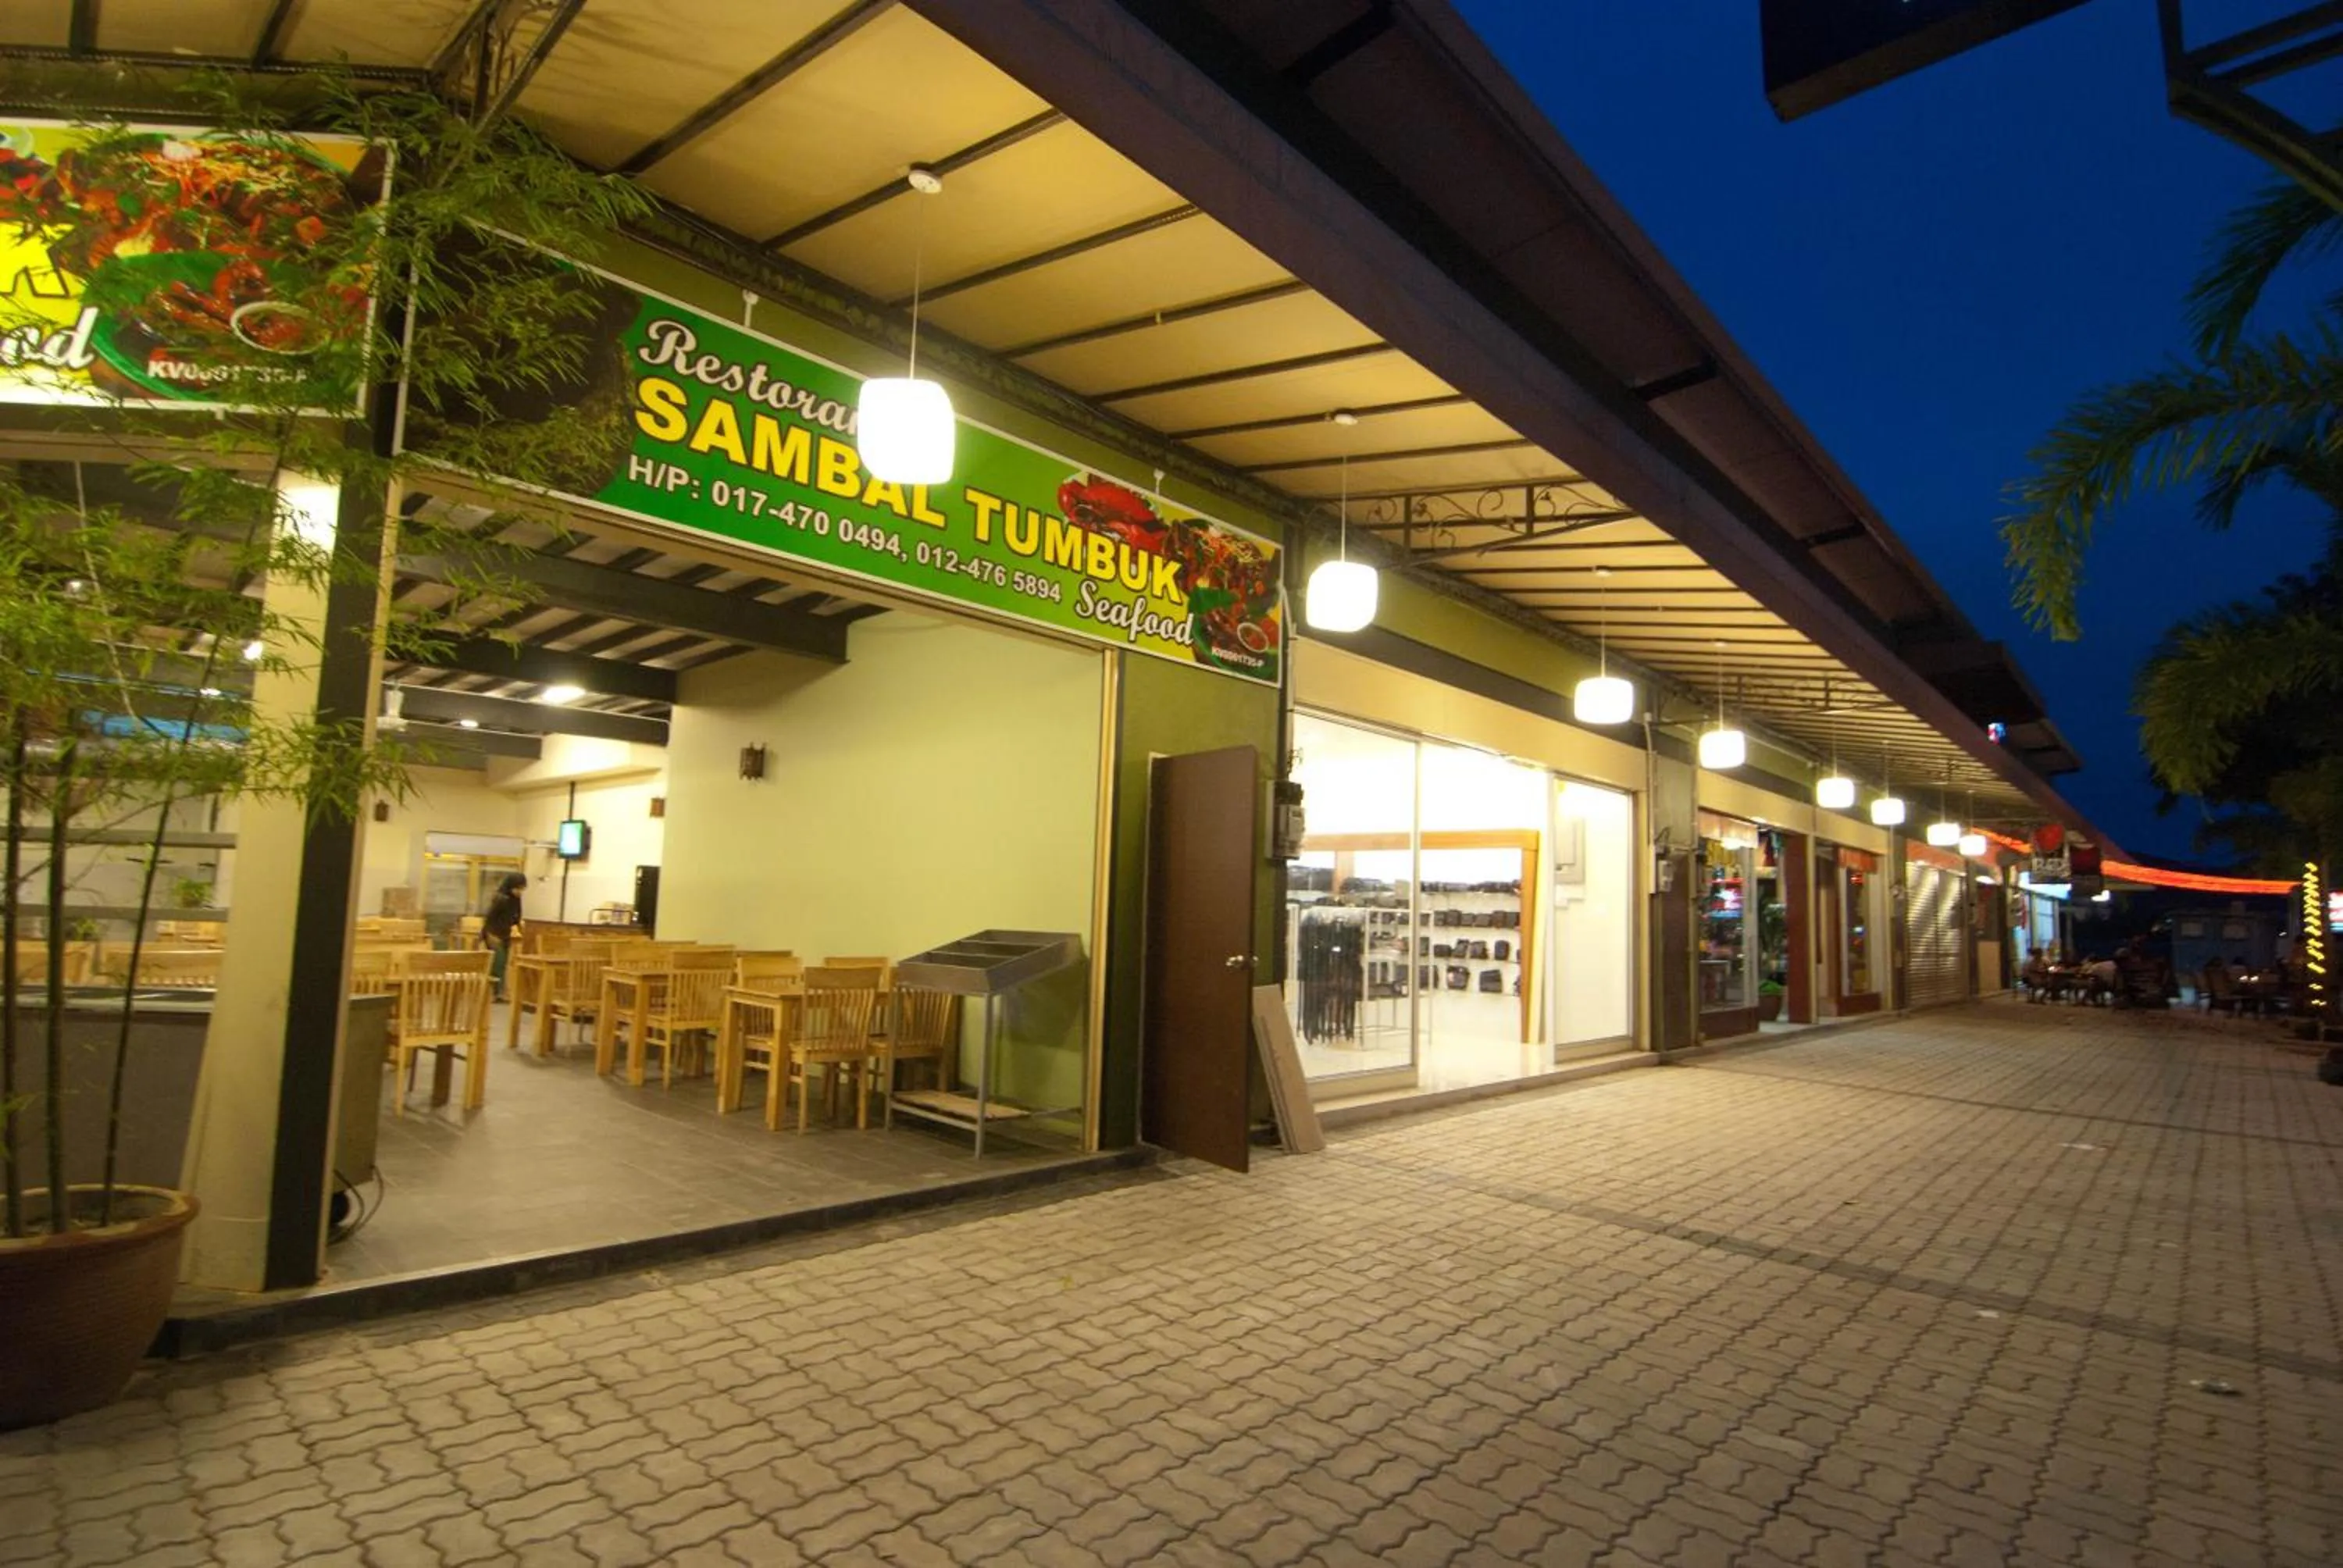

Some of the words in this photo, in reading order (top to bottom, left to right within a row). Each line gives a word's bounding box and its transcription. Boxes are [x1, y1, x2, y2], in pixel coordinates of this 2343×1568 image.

[628, 454, 700, 499] H/P:
[711, 480, 830, 535] 017-470
[838, 519, 908, 562] 0494,
[916, 542, 1006, 587] 012-476
[1013, 573, 1061, 603] 5894
[634, 377, 946, 528] SAMBAL
[965, 488, 1183, 604] TUMBUK
[1075, 579, 1194, 645] Seafood
